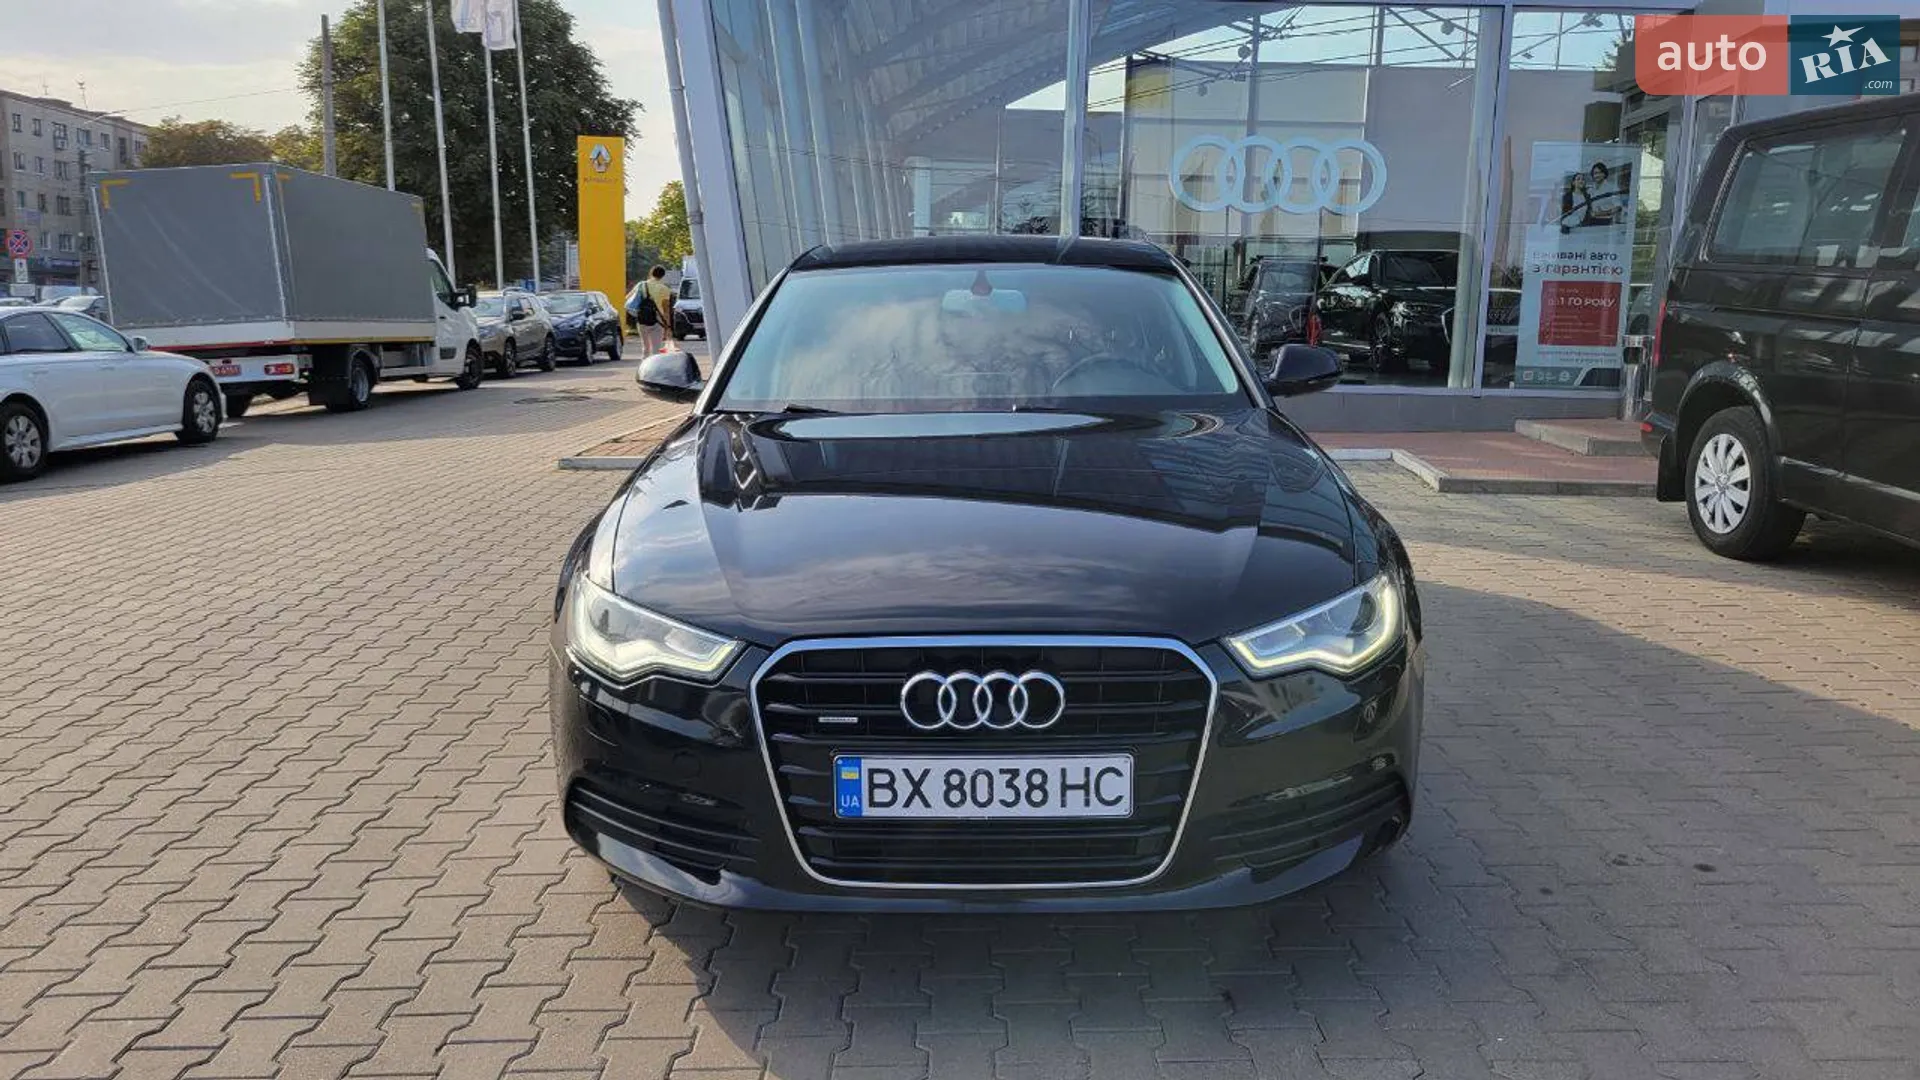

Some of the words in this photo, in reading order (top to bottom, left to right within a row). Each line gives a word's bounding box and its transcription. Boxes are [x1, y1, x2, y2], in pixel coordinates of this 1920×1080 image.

[1590, 251, 1617, 261] авто
[1546, 262, 1624, 277] гарантією
[867, 768, 932, 808] BX
[943, 768, 1050, 808] 8038
[1060, 766, 1125, 808] HC
[841, 795, 860, 808] UA
